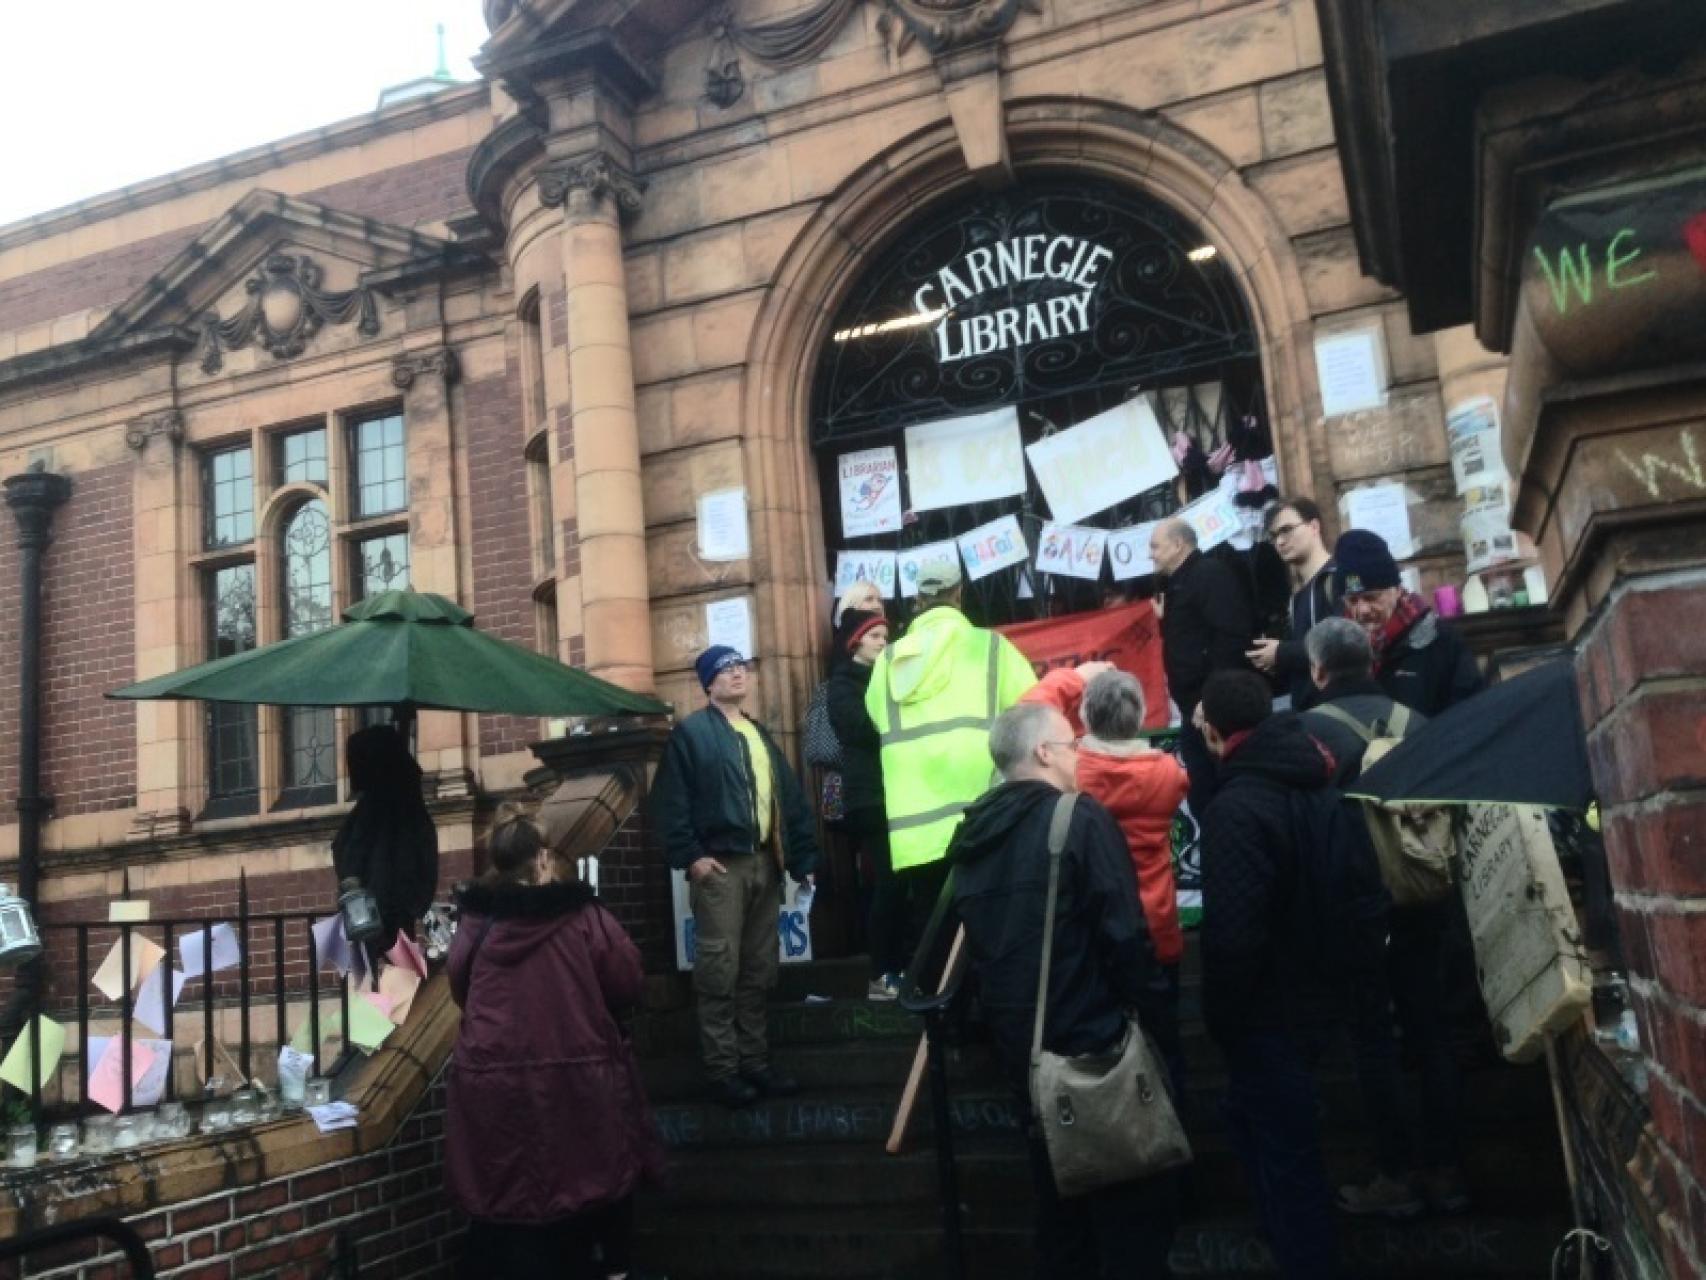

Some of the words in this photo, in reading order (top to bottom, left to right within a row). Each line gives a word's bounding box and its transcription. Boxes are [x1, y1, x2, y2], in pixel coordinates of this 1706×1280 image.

[914, 234, 1114, 315] CARNEGIE
[1533, 228, 1659, 315] WE
[936, 290, 1092, 363] LIBRARY
[842, 460, 896, 479] LIBRARIAN
